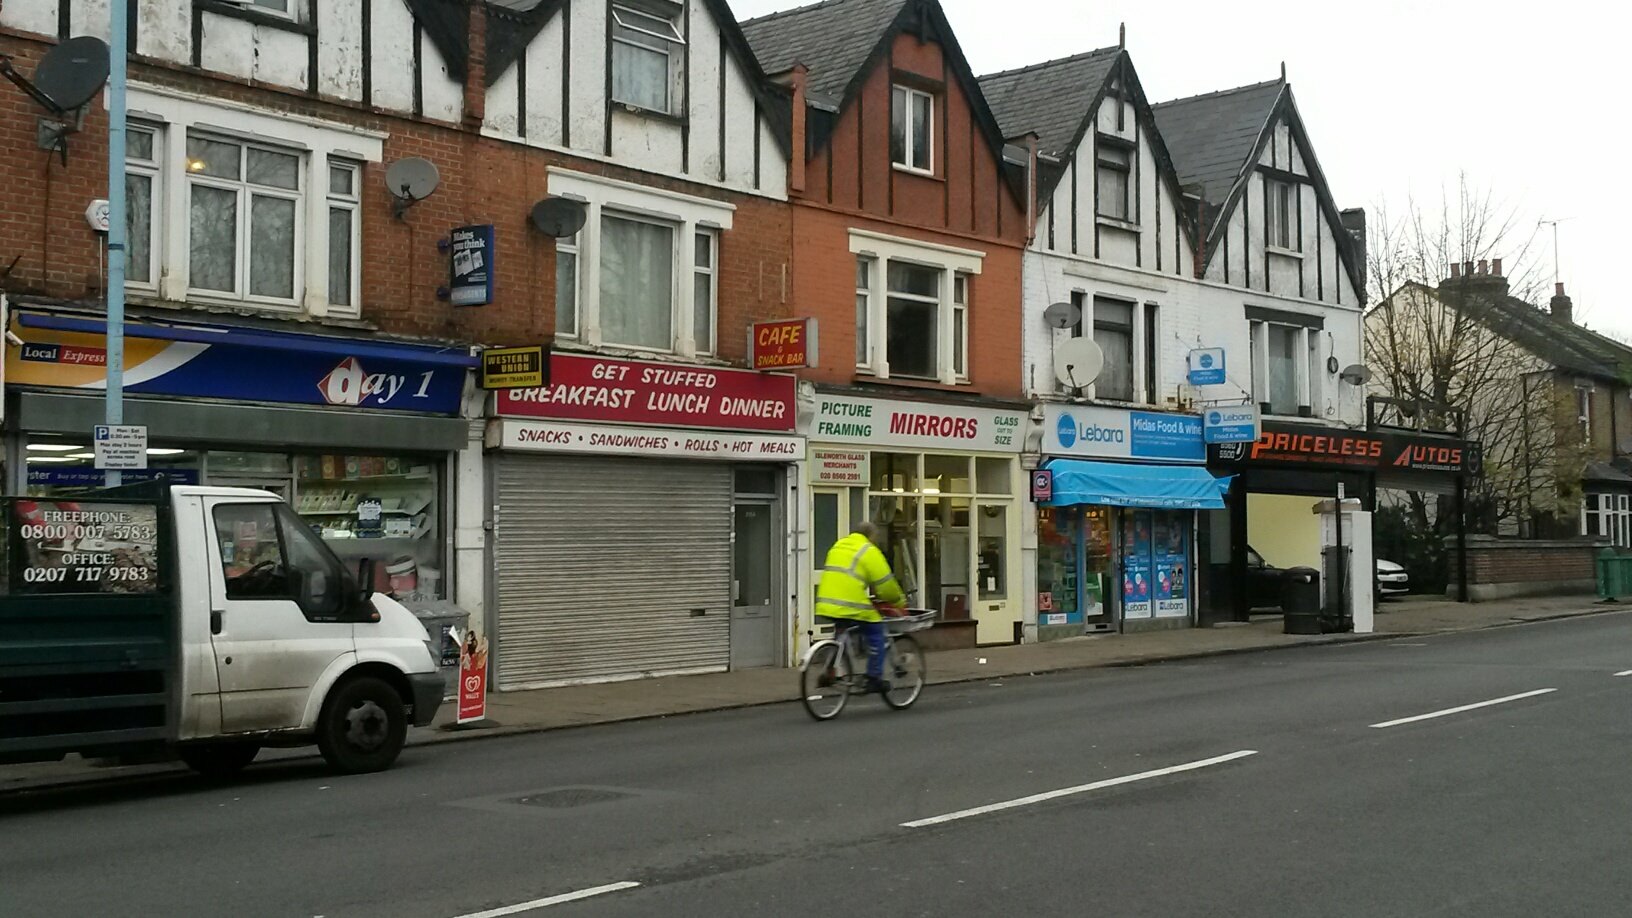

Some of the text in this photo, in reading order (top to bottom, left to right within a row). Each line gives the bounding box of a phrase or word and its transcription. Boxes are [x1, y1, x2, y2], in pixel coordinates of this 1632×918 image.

[464, 238, 485, 249] think
[758, 325, 802, 346] CAFE
[25, 347, 106, 363] Local Express
[487, 353, 530, 366] WESTERN
[757, 352, 804, 366] SNACK BAR
[501, 363, 529, 373] UNION
[327, 356, 434, 404] day 1
[510, 375, 537, 383] TRANSFER
[591, 363, 717, 389] GET STUFFED
[508, 383, 786, 419] BREAKFAST LUNCH DINNER
[820, 401, 873, 418] PICTURE
[994, 415, 1019, 427] GLASS
[1223, 413, 1253, 422] Lebara
[817, 421, 872, 438] FRAMING
[889, 412, 978, 440] MIRRORS
[1079, 422, 1124, 443] Lebara
[1133, 417, 1156, 432] Midas
[1157, 420, 1177, 434] Food
[1178, 422, 1185, 434] &
[98, 428, 108, 439] P
[518, 428, 797, 454] SNACKS SANDWICHES ROLLS HOT MEALS
[994, 435, 1012, 445] SIZE
[1250, 432, 1382, 459] PRICELESS
[1392, 444, 1462, 466] AUTOS
[823, 461, 857, 469] MERCHANTS
[43, 511, 132, 523] FREEPHONE:
[20, 525, 151, 540] 0800 007 5783
[61, 553, 115, 565] OFFICE:
[23, 566, 149, 582] 0207 717 9783
[1164, 602, 1184, 611] Lebara
